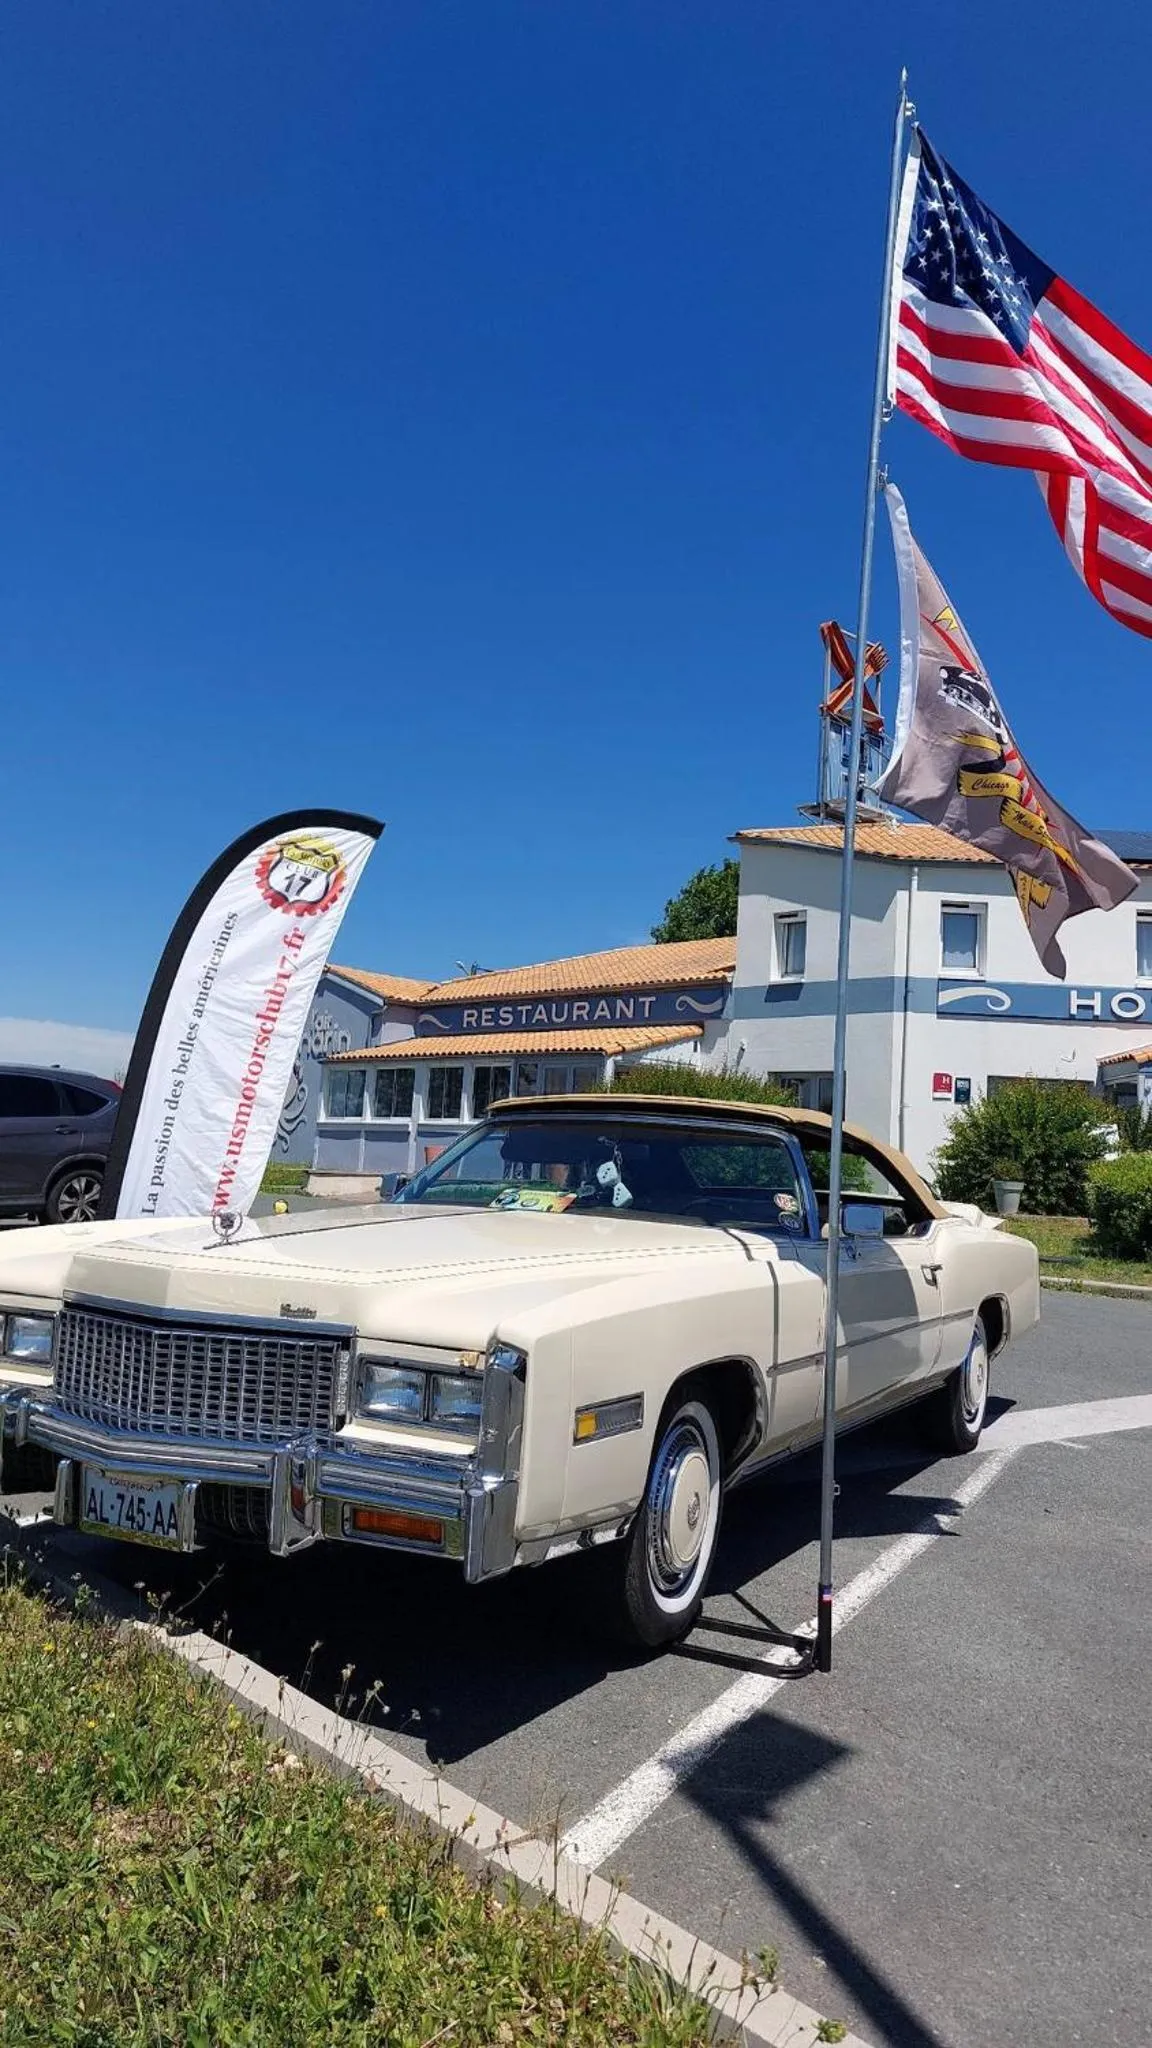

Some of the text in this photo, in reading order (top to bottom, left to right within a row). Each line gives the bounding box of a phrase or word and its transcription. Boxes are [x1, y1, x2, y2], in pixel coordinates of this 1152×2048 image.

[284, 872, 313, 897] 17
[141, 910, 238, 1217] La passion des belles américaines
[212, 926, 307, 1214] ww.usmotorsclub17.fr
[462, 996, 657, 1028] RESTAURANT
